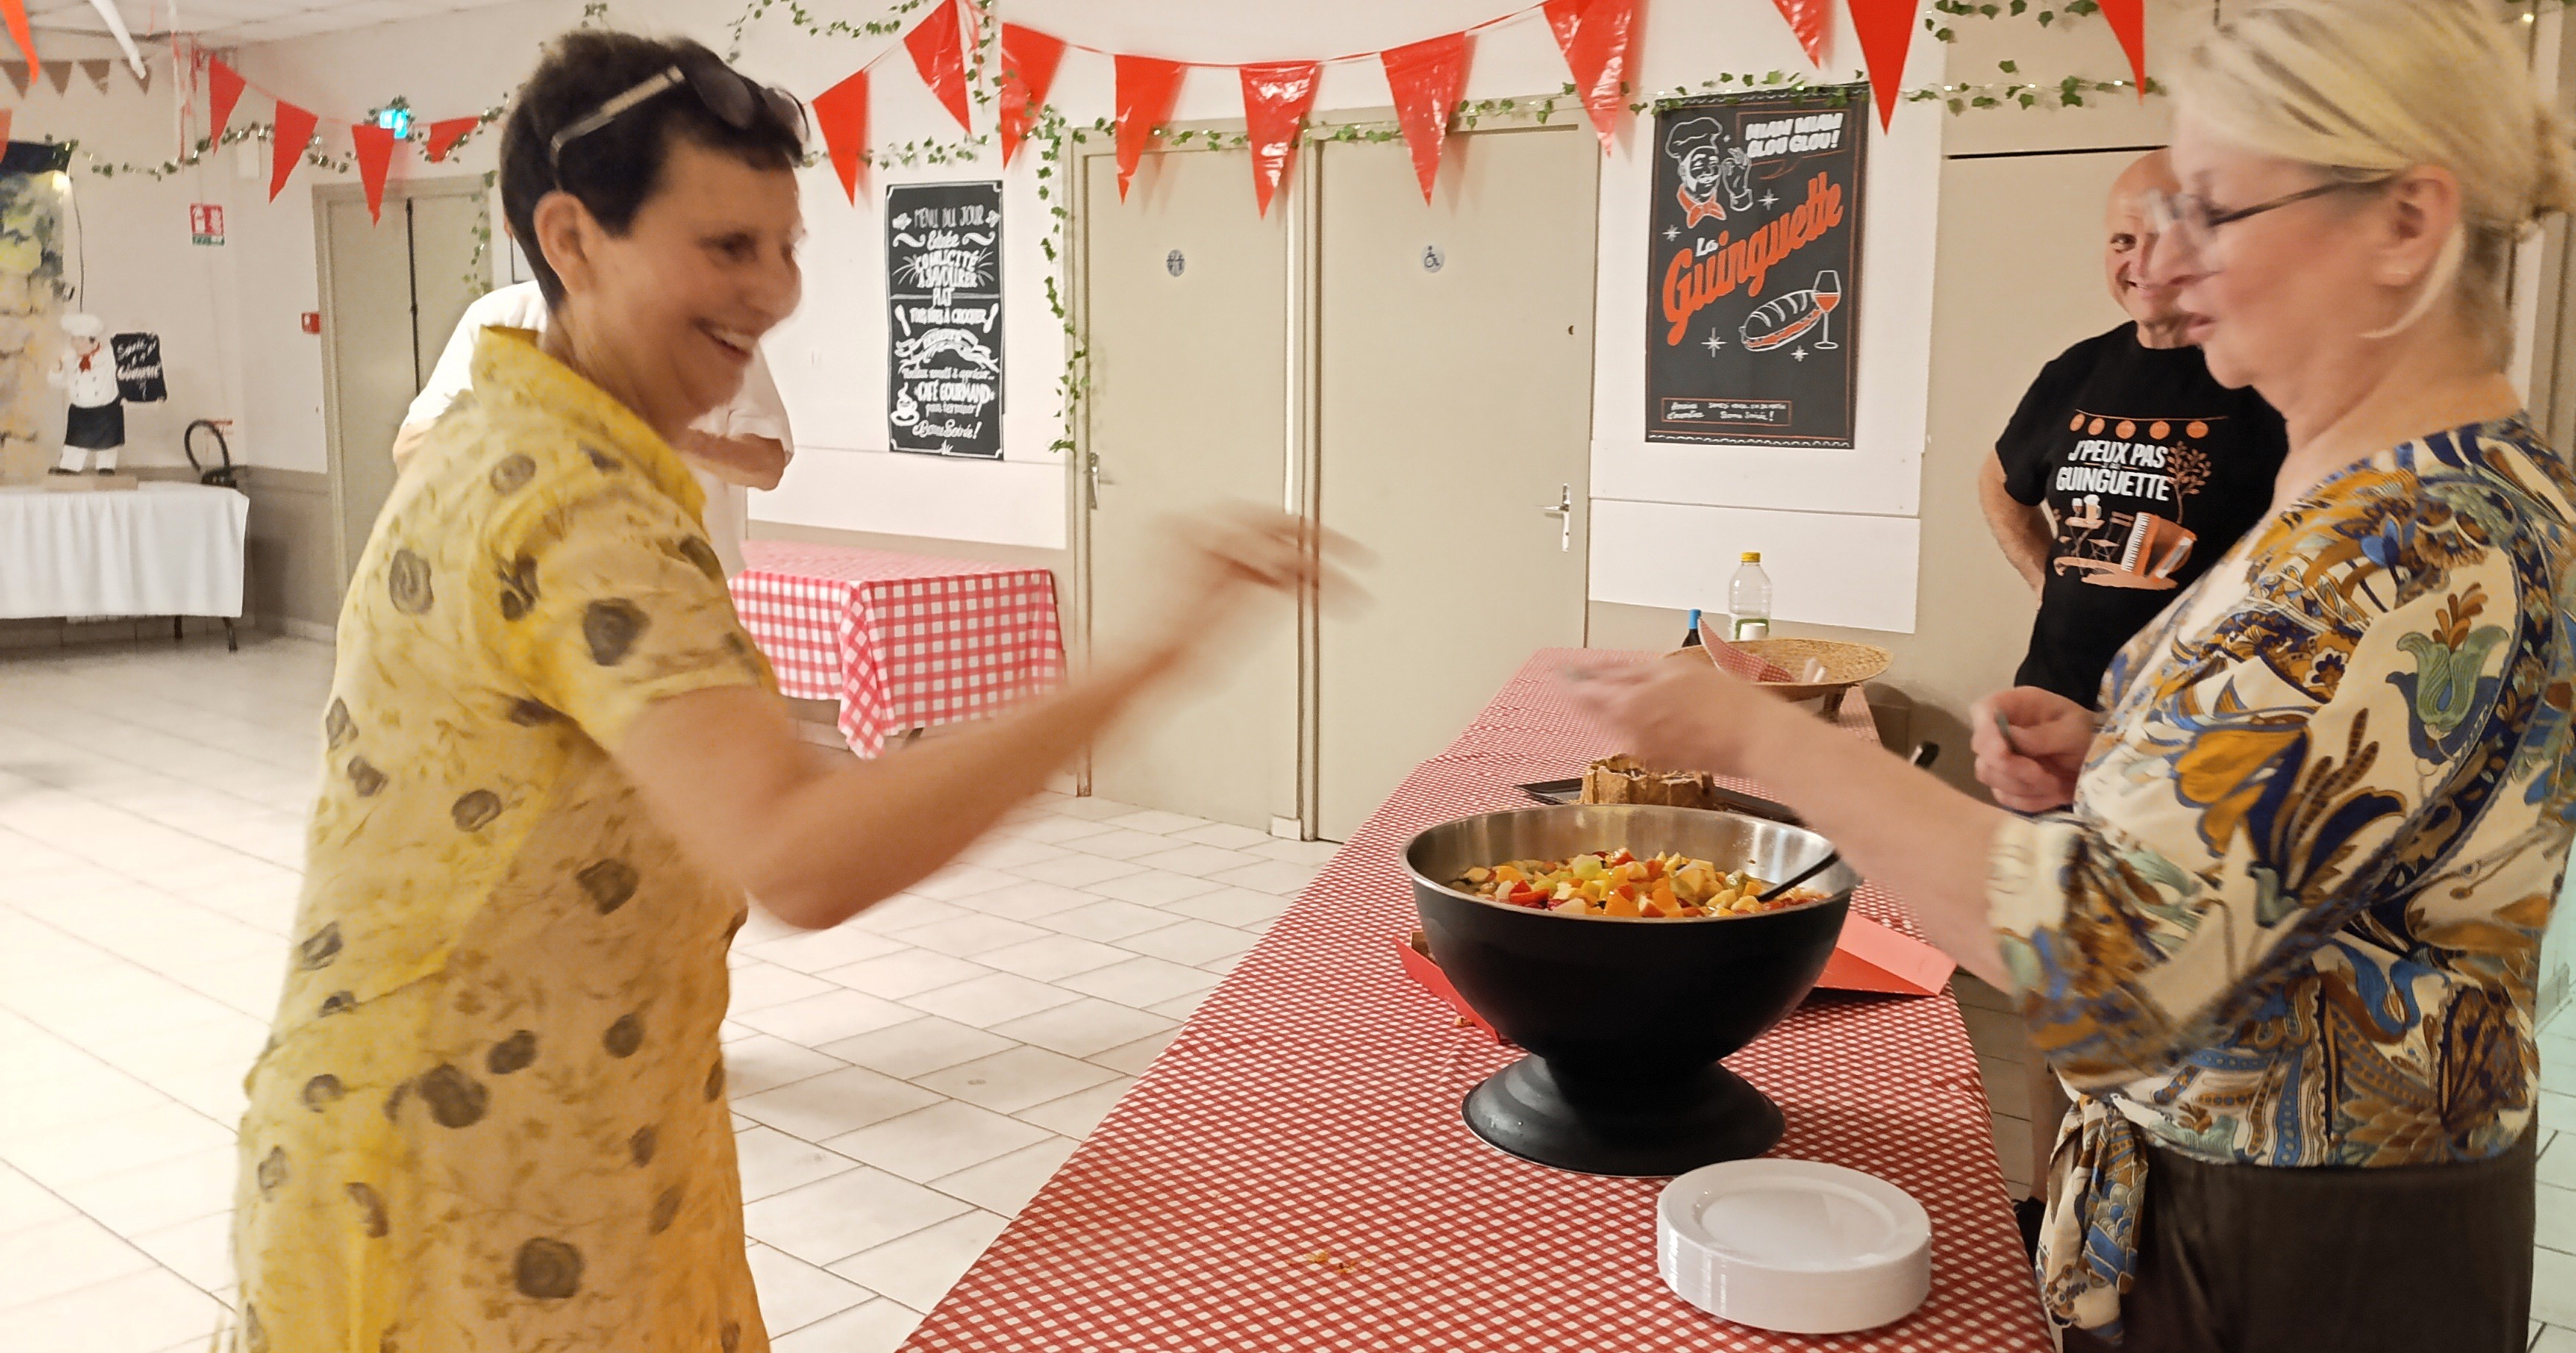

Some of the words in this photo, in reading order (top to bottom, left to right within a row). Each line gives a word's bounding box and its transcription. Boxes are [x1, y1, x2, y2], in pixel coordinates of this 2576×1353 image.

[1662, 171, 1845, 346] Guinguette
[1695, 238, 1719, 257] La
[2067, 440, 2132, 465] J'PEUX
[2130, 443, 2168, 468] PAS
[2056, 466, 2170, 501] GUINGUETTE
